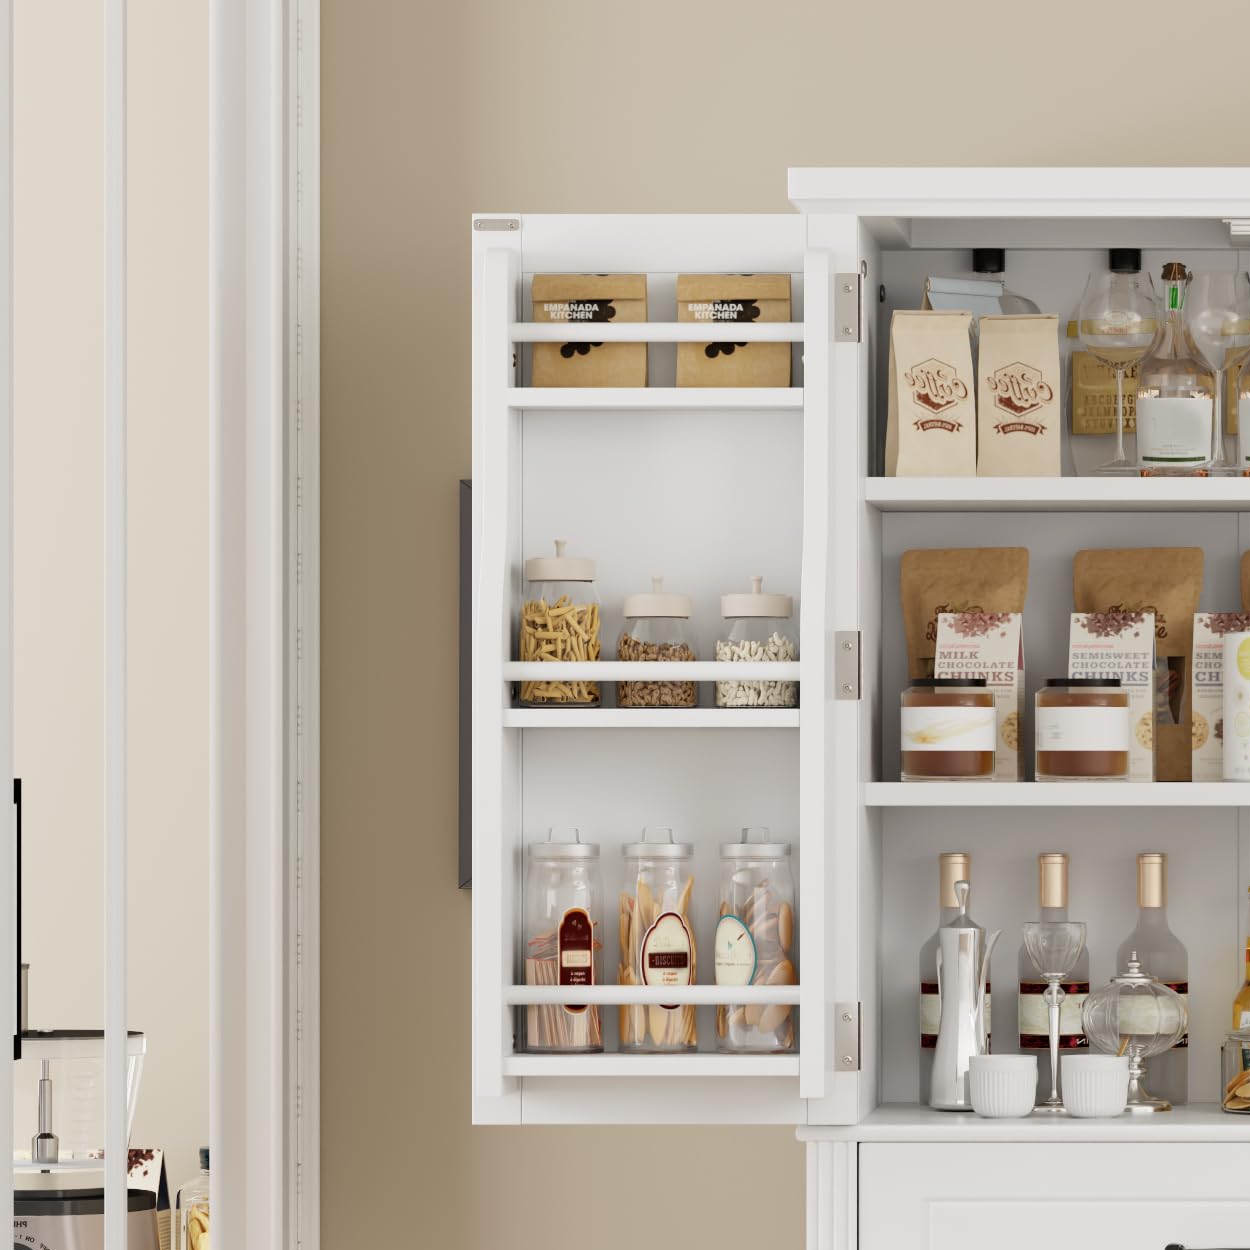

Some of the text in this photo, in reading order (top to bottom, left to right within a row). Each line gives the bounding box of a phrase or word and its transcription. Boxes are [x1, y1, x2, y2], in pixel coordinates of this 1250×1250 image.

[543, 303, 599, 312] EMPANADA
[688, 303, 743, 312] EMPANADA
[550, 311, 593, 320] KITCHEN
[694, 311, 738, 320] KITCHEN
[939, 651, 979, 659] MILK
[1071, 652, 1150, 660] SEMISWEET
[937, 661, 1015, 669] CHOCOLATE
[1071, 661, 1150, 669] CHOCOLATE
[937, 671, 1015, 682] CHUNKS
[1071, 671, 1149, 682] CHUNKS
[1194, 671, 1223, 682] CH
